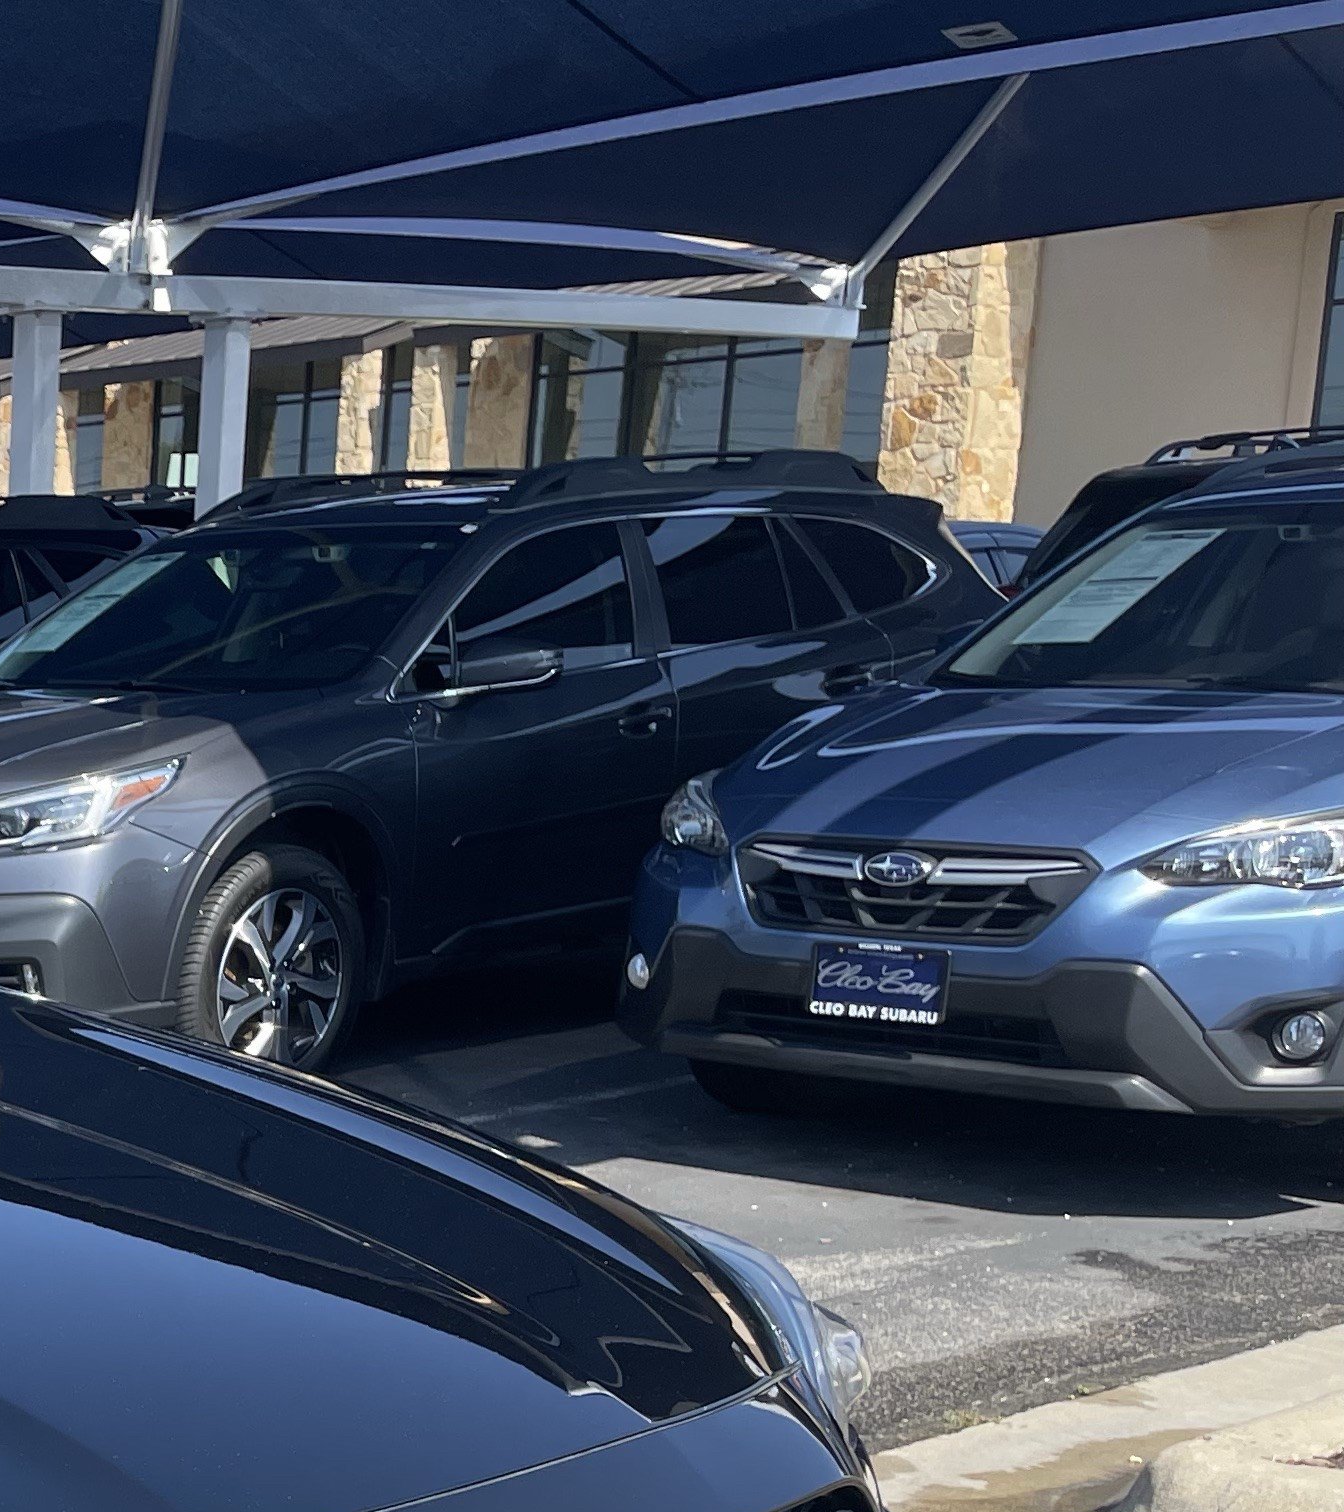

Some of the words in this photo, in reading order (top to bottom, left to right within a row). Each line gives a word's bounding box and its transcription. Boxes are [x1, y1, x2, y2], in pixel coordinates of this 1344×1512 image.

[817, 959, 878, 990] Cleo
[877, 965, 940, 1003] Bay
[809, 1000, 845, 1016] CLEO
[847, 1003, 877, 1019] BAY
[880, 1006, 938, 1025] SUBARU
